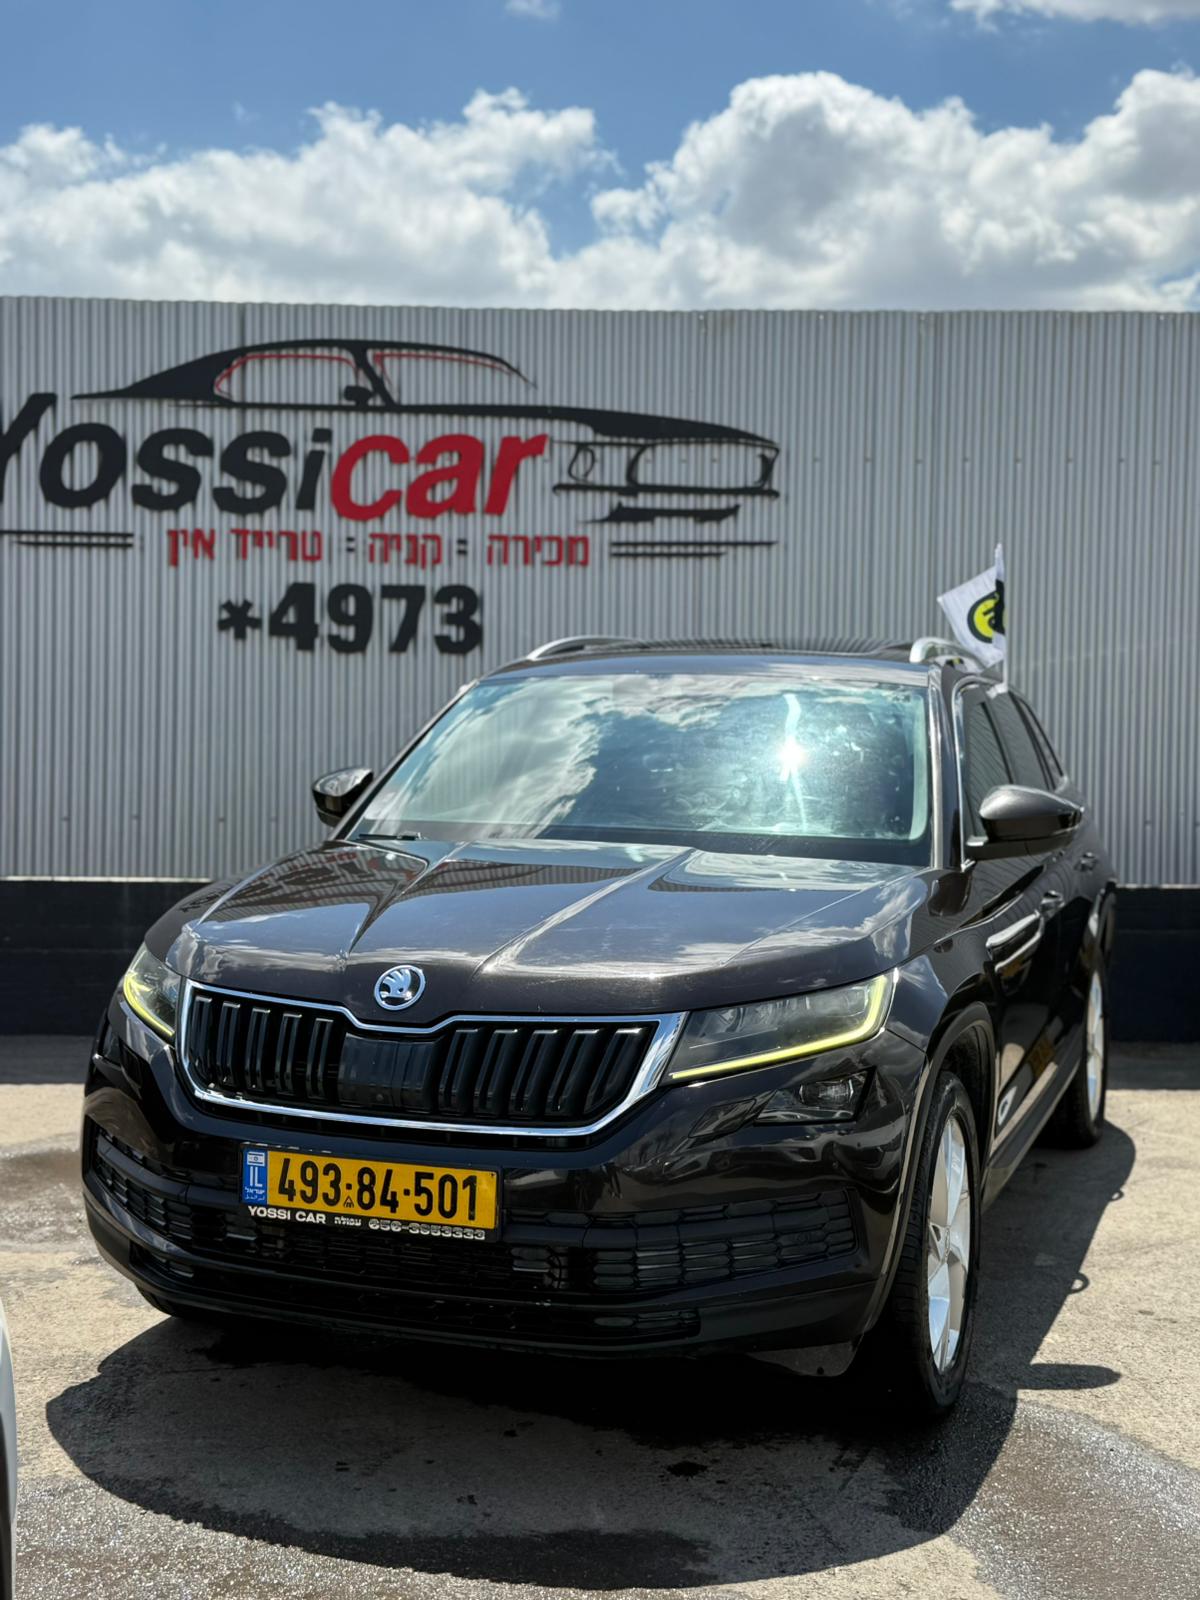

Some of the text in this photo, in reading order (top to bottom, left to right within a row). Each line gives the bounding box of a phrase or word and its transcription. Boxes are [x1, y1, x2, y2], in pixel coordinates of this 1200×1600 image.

[167, 528, 215, 569] אין
[230, 528, 323, 562] טרייד
[368, 532, 443, 571] קניה
[487, 534, 590, 567] מכירה
[249, 1165, 263, 1188] IL
[248, 1205, 291, 1220] YOSSI
[295, 1210, 327, 1224] CAR
